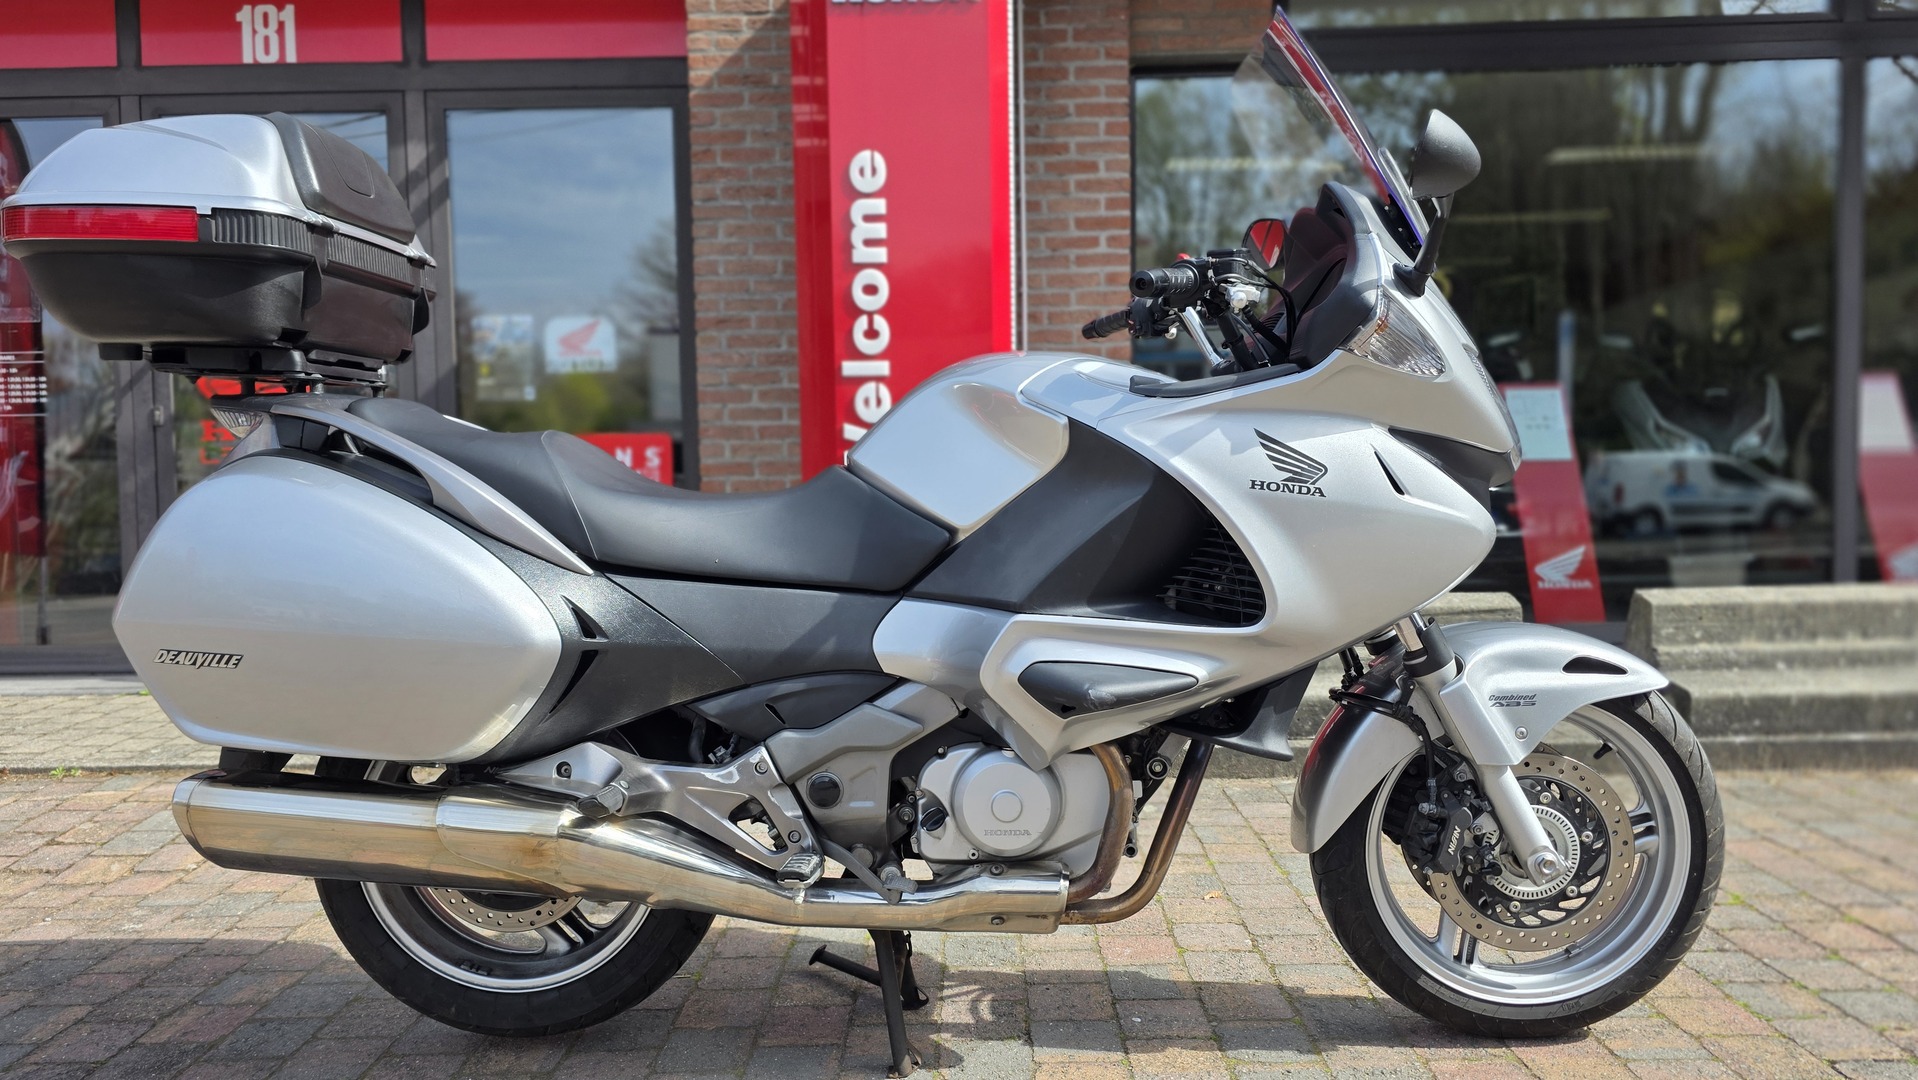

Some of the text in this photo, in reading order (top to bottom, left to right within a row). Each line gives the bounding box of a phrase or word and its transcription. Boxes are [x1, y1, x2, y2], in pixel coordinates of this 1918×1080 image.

[235, 4, 297, 64] 181
[1249, 479, 1327, 498] HONDA
[153, 649, 243, 669] DEAUVILLE
[1488, 693, 1537, 701] Combined
